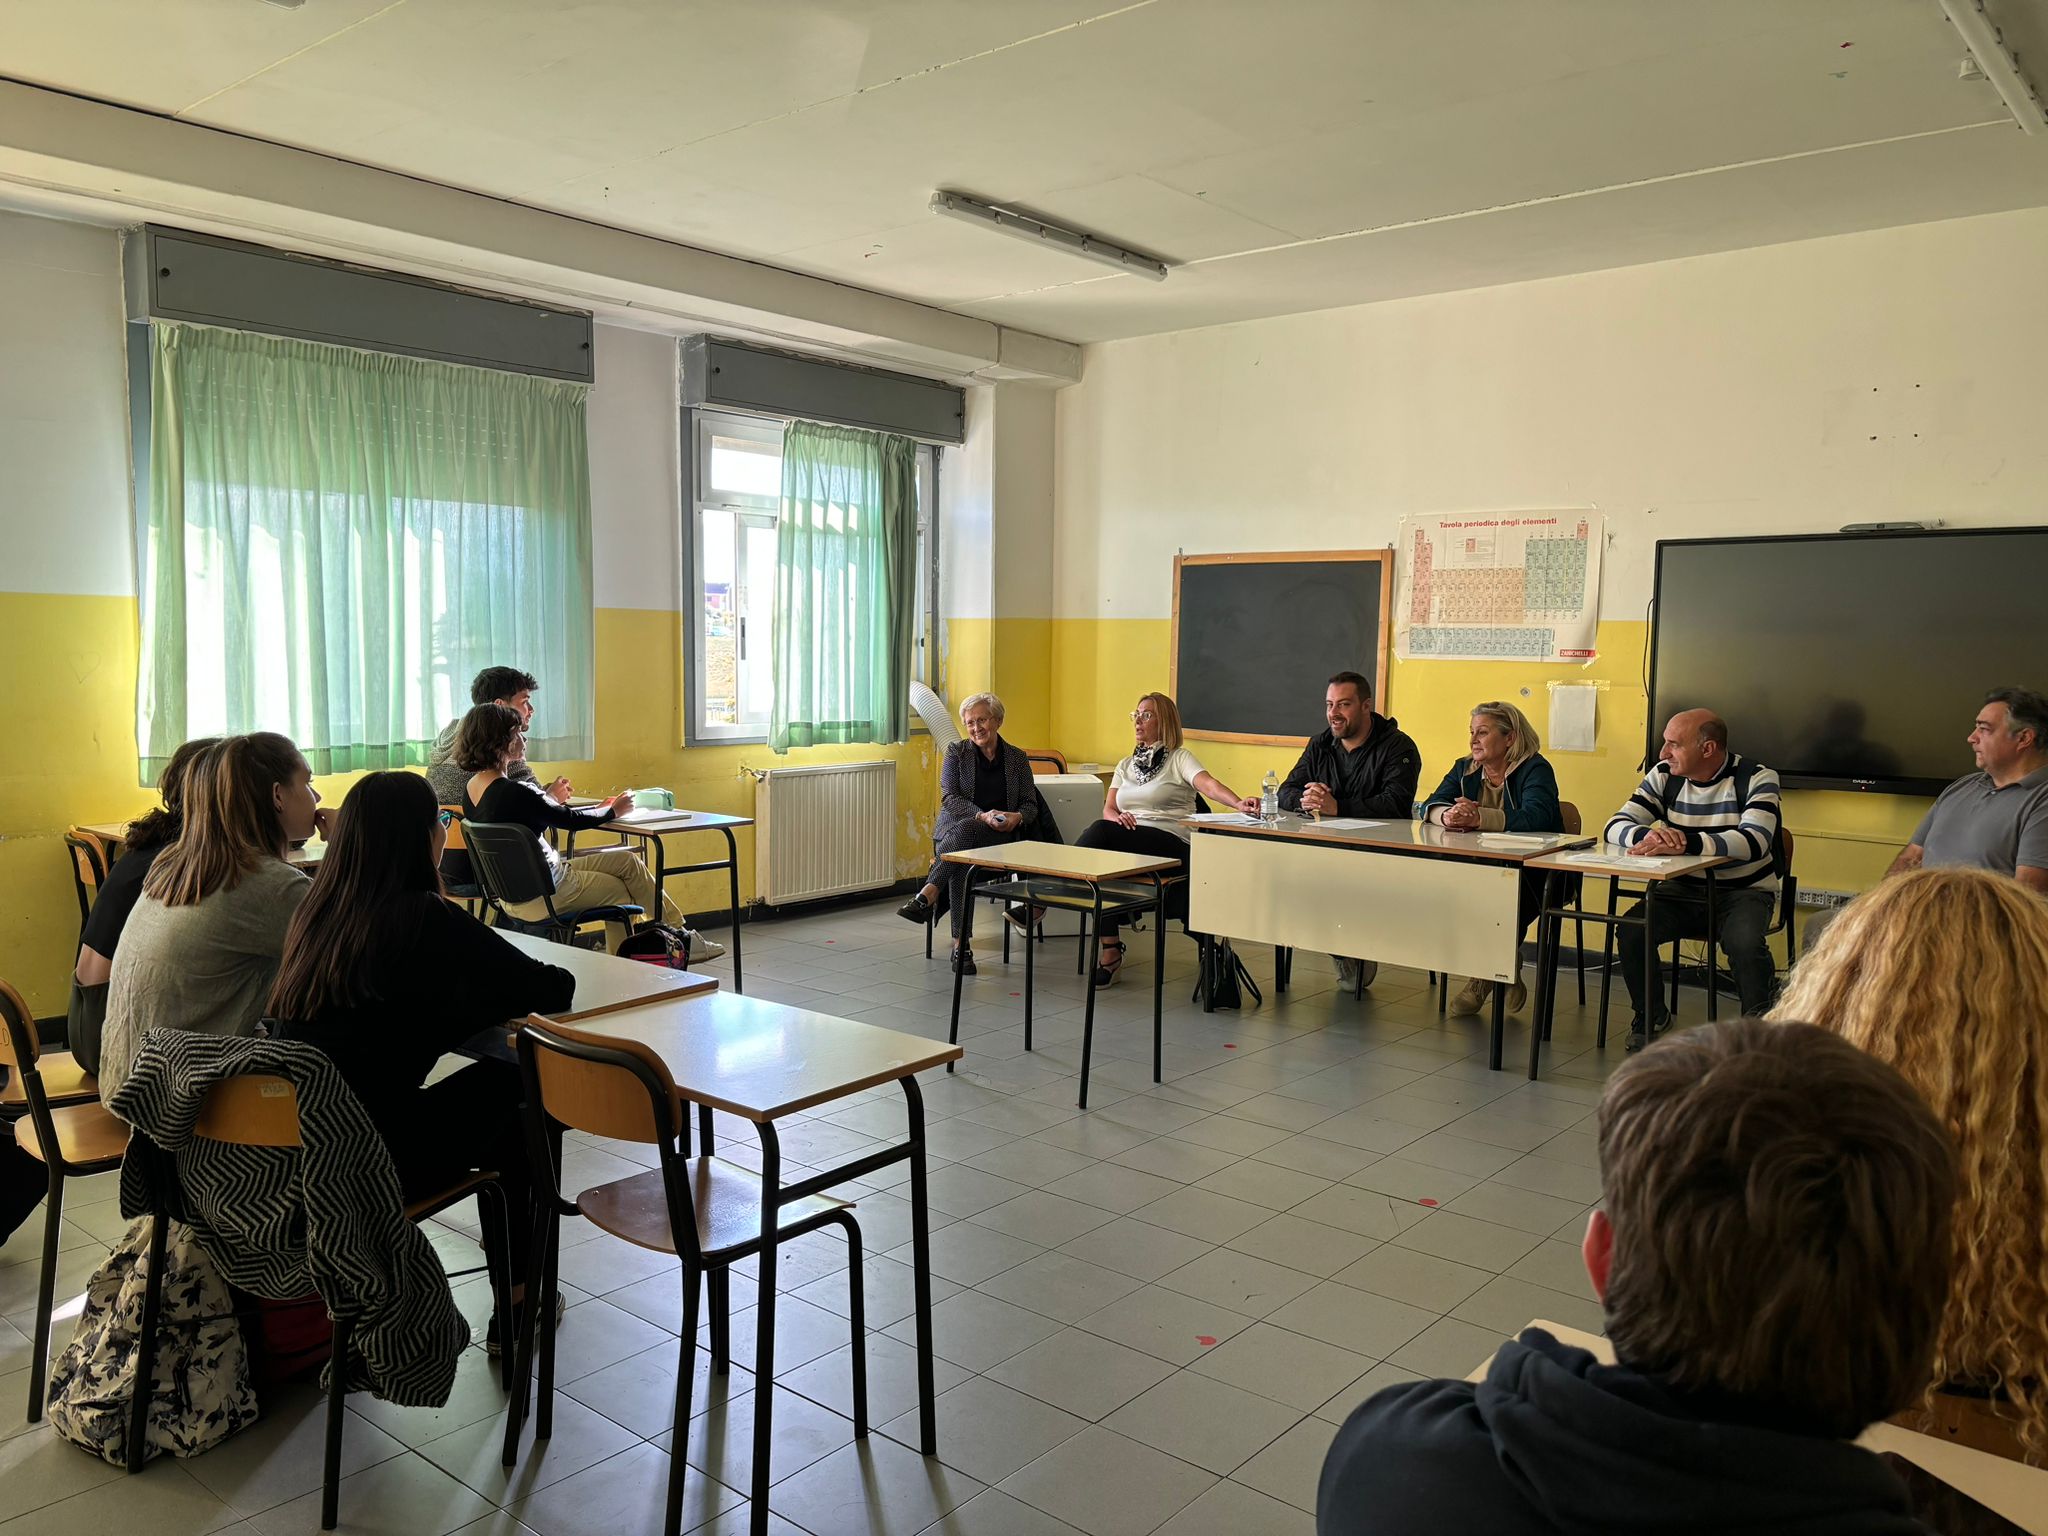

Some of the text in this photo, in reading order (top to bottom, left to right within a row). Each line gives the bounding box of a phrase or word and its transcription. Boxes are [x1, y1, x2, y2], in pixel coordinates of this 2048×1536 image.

[1439, 517, 1557, 529] Tavola periodica degli elementi
